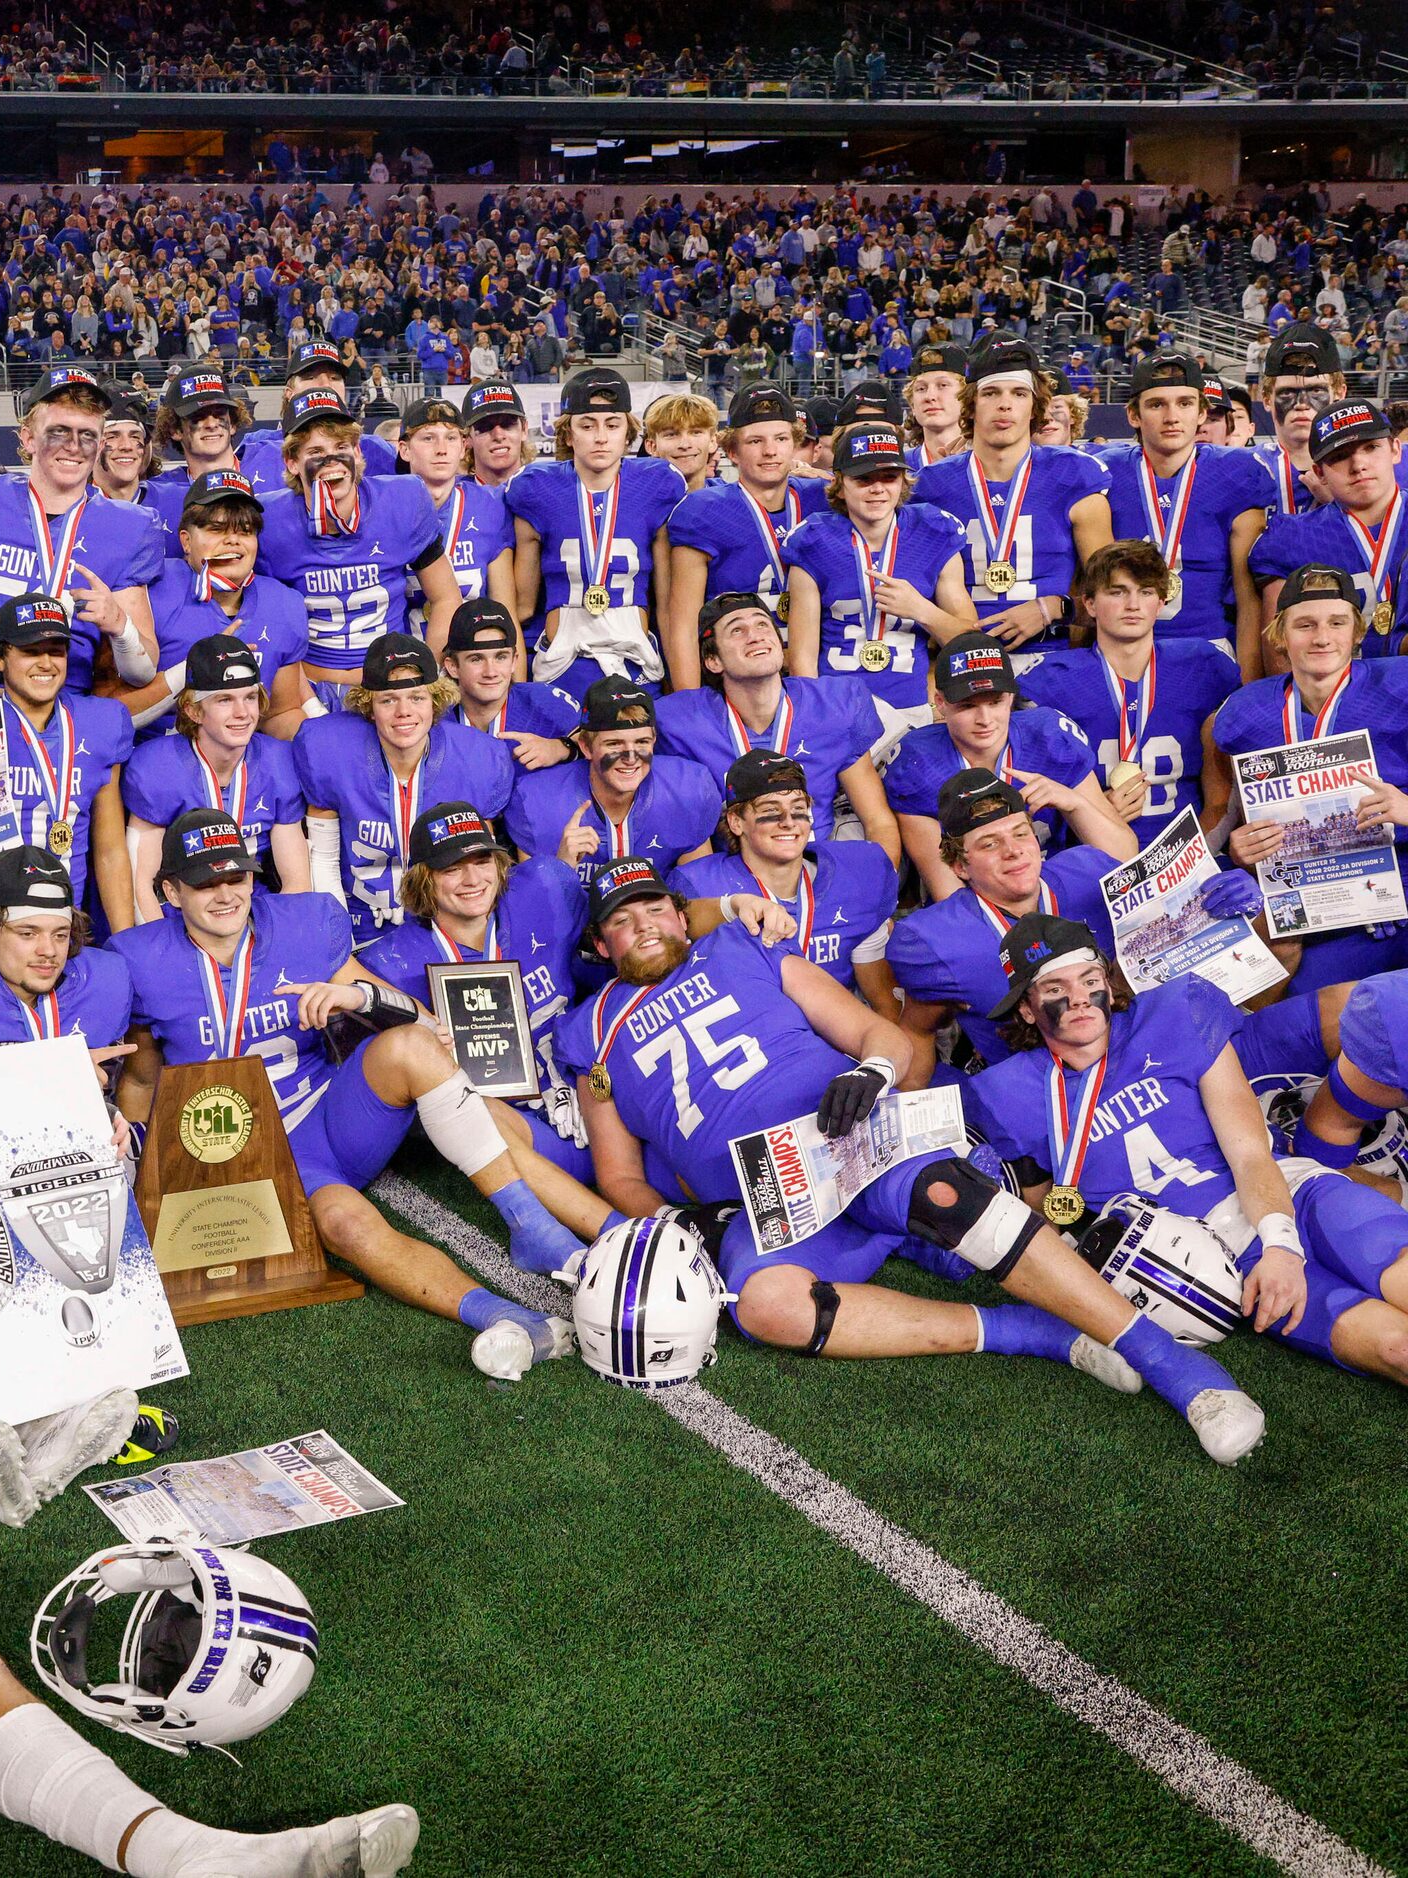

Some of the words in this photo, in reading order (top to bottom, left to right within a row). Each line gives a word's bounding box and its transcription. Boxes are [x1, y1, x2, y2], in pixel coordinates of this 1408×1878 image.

[193, 374, 222, 384] TEXAS
[306, 392, 338, 403] TEXAS
[1329, 405, 1369, 422] TEXAS
[1332, 413, 1373, 430] STRONG
[868, 435, 898, 444] TEXAS
[305, 564, 380, 593] GUNTER
[560, 538, 640, 608] 13
[304, 585, 390, 650] 22
[965, 649, 1001, 659] TEXAS
[967, 658, 1003, 669] STRONG
[1284, 752, 1317, 765] TEXAS
[1286, 754, 1346, 771] FOOTBALL
[1242, 763, 1274, 775] STATE
[1244, 778, 1294, 805] STATE
[444, 812, 480, 825] TEXAS
[200, 824, 237, 838] TEXAS
[203, 835, 240, 847] STRONG
[609, 862, 650, 879] TEXAS
[1304, 860, 1327, 869] GUNTER
[1351, 859, 1378, 868] DIVISION
[614, 870, 654, 888] STRONG
[1112, 881, 1154, 920] STATE
[1156, 836, 1206, 893] CHAMPS!
[1326, 869, 1363, 880] CHAMPIONS
[1166, 942, 1188, 959] GUNTER
[1170, 953, 1186, 965] YOUR
[1186, 946, 1201, 959] 2022
[1209, 930, 1233, 944] DIVISION
[1175, 961, 1191, 973] STATE
[1192, 943, 1224, 964] CHAMPIONS
[624, 972, 718, 1043] GUNTER
[471, 1022, 514, 1030] Championships
[467, 1040, 510, 1058] MVP
[632, 994, 769, 1141] 75
[188, 1085, 250, 1114] INTERSCHOLASTIC
[202, 1136, 232, 1147] STATE
[13, 1153, 93, 1178] CHAMPIONS
[767, 1125, 809, 1197] CHAMPS!
[1123, 1121, 1219, 1198] 4
[19, 1172, 99, 1196] TIGERS
[758, 1157, 780, 1209] FOOTBALL
[31, 1194, 109, 1225] 2022
[167, 1204, 197, 1242] UNIVERSITY
[196, 1194, 254, 1212] INTERSCHOLASTIC
[787, 1194, 819, 1239] STATE
[192, 1222, 213, 1233] STATE
[213, 1217, 248, 1230] CHAMPION
[203, 1229, 238, 1239] FOOTBALL
[191, 1237, 236, 1251] CONFERENCE
[236, 1235, 250, 1244] AAA
[205, 1248, 233, 1257] DIVISION
[1109, 1250, 1130, 1272] THE
[76, 1265, 107, 1284] 15-0
[213, 1267, 232, 1276] 2022
[150, 1367, 169, 1381] CONCEPT
[264, 1444, 312, 1475] STATE
[293, 1471, 363, 1517] CHAMPS!
[210, 1574, 233, 1601] FOR
[213, 1608, 235, 1641] THE
[186, 1647, 228, 1694] BRAND
